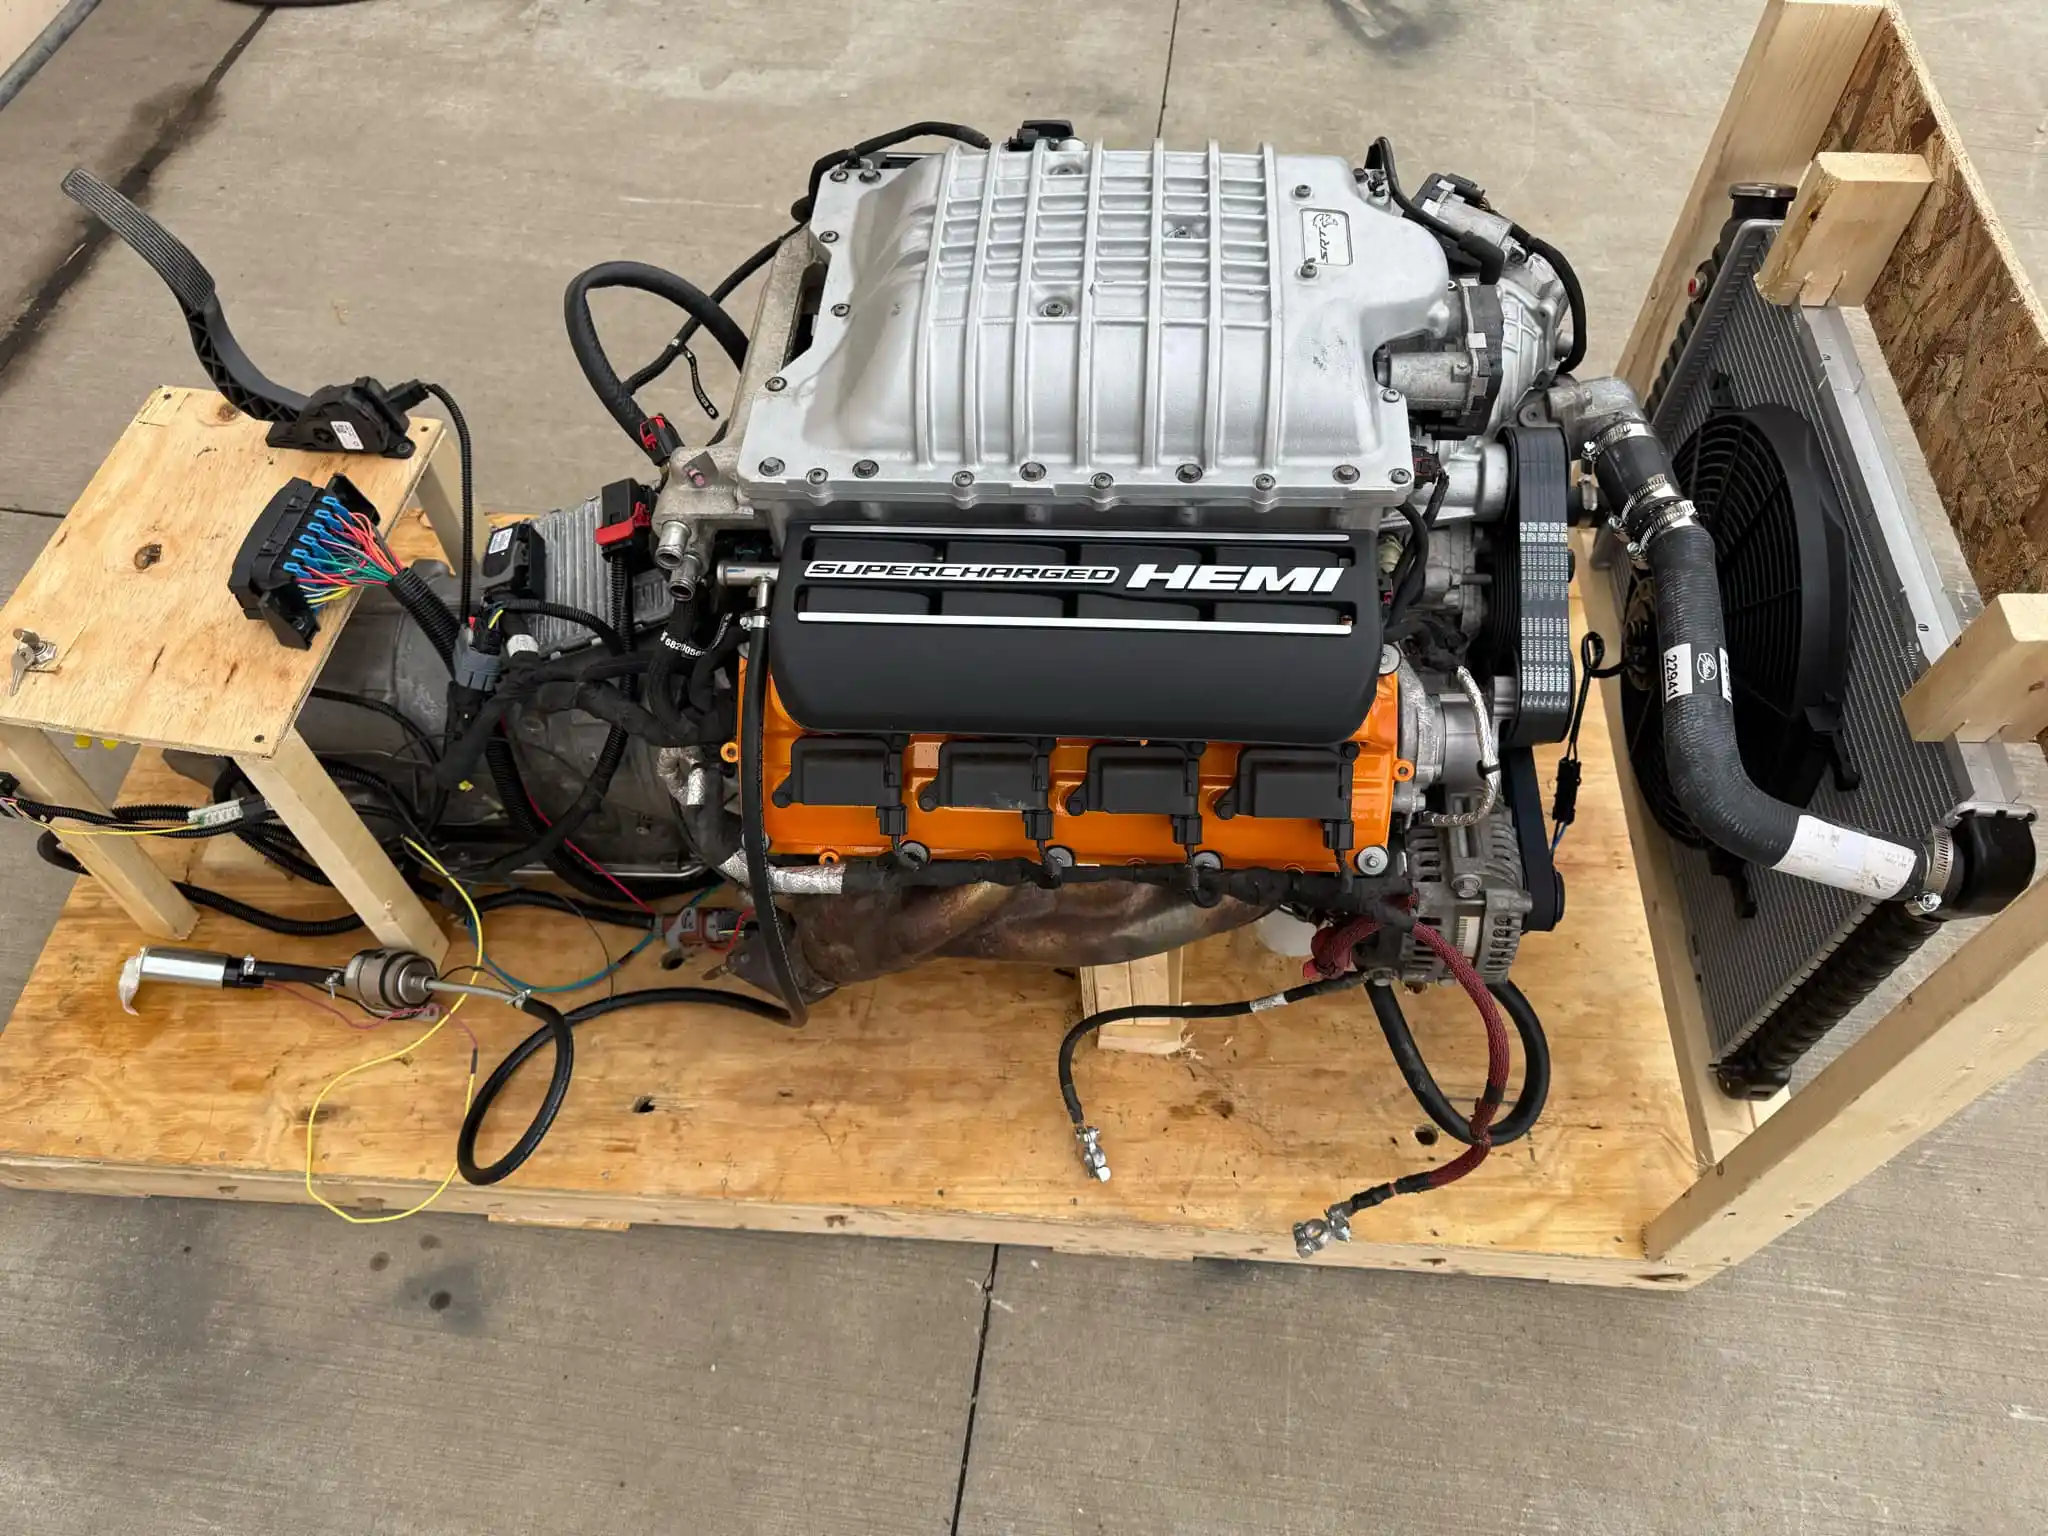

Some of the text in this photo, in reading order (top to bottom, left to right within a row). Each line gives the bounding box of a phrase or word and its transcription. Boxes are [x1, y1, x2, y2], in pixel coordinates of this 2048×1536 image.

[808, 562, 1345, 592] SUPERCHARGED HEMI
[1666, 655, 1679, 698] 22941
